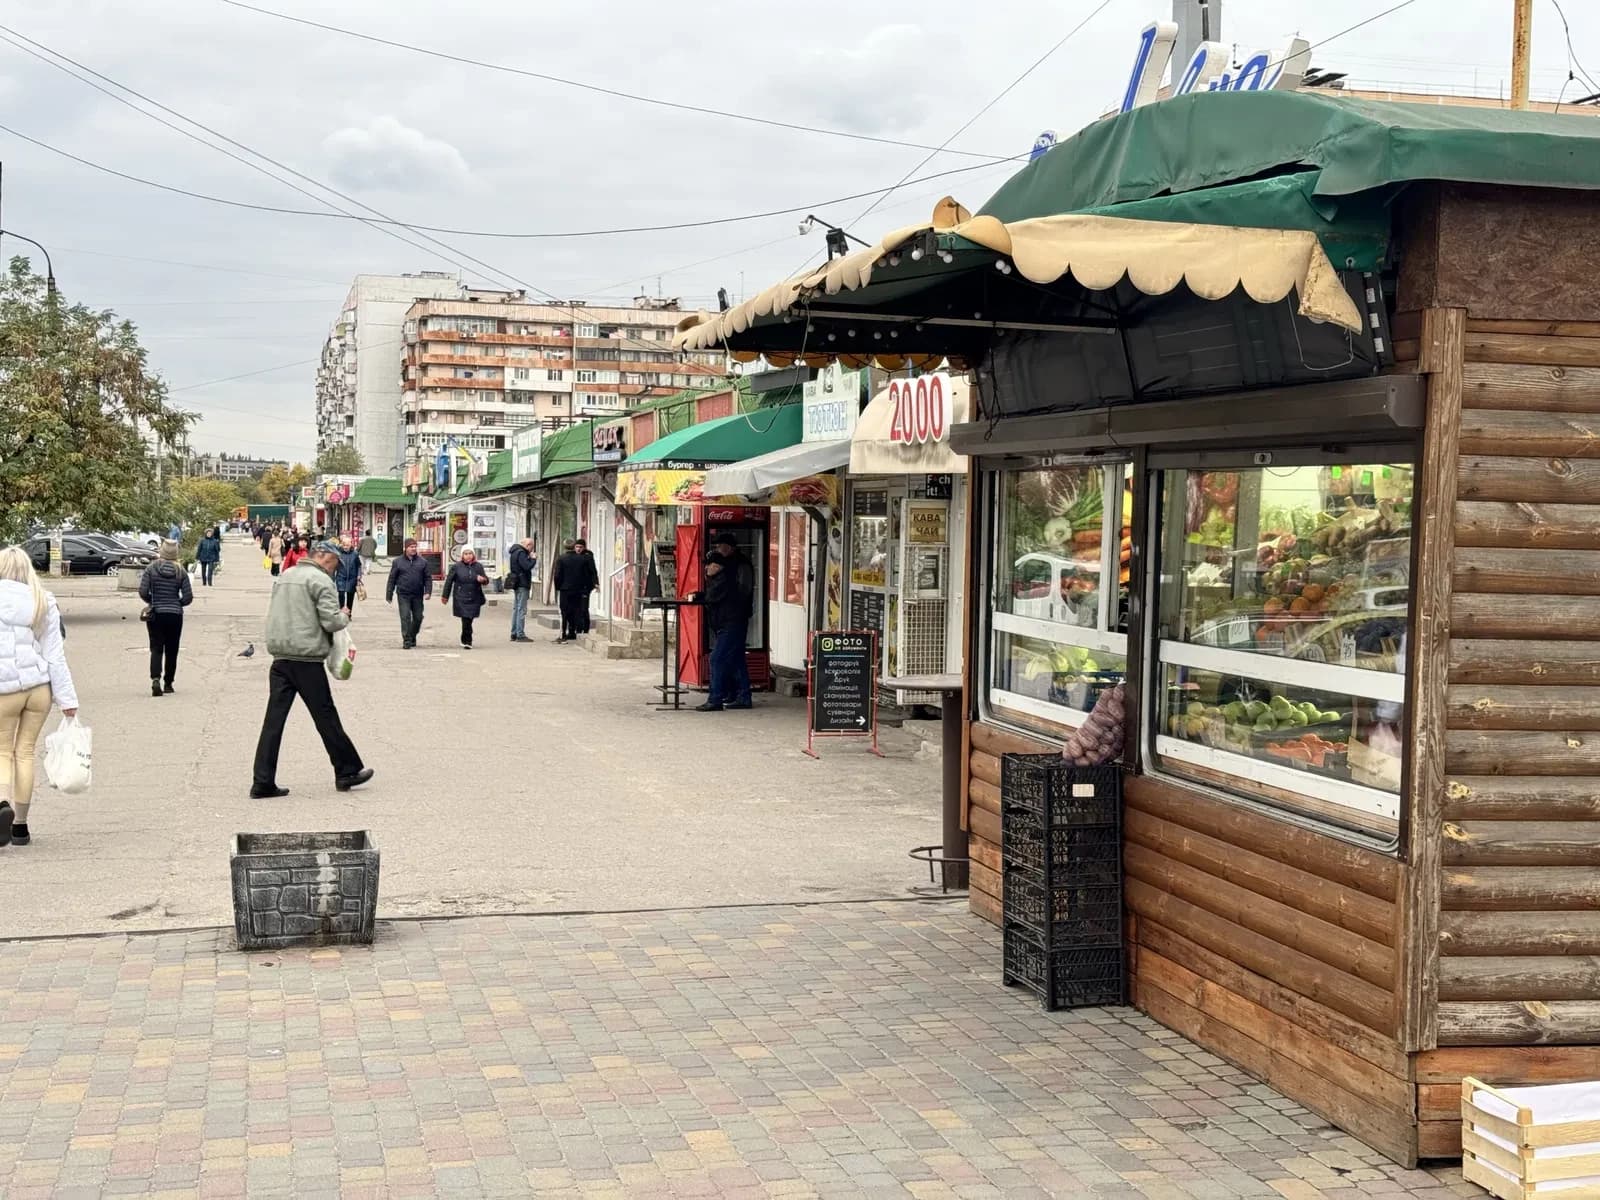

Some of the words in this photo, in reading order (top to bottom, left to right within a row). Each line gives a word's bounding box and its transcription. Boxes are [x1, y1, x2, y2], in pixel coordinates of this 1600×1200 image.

[888, 375, 943, 443] 2000
[667, 461, 694, 470] бургер
[913, 513, 941, 522] КАВА
[834, 638, 863, 646] ФОТО
